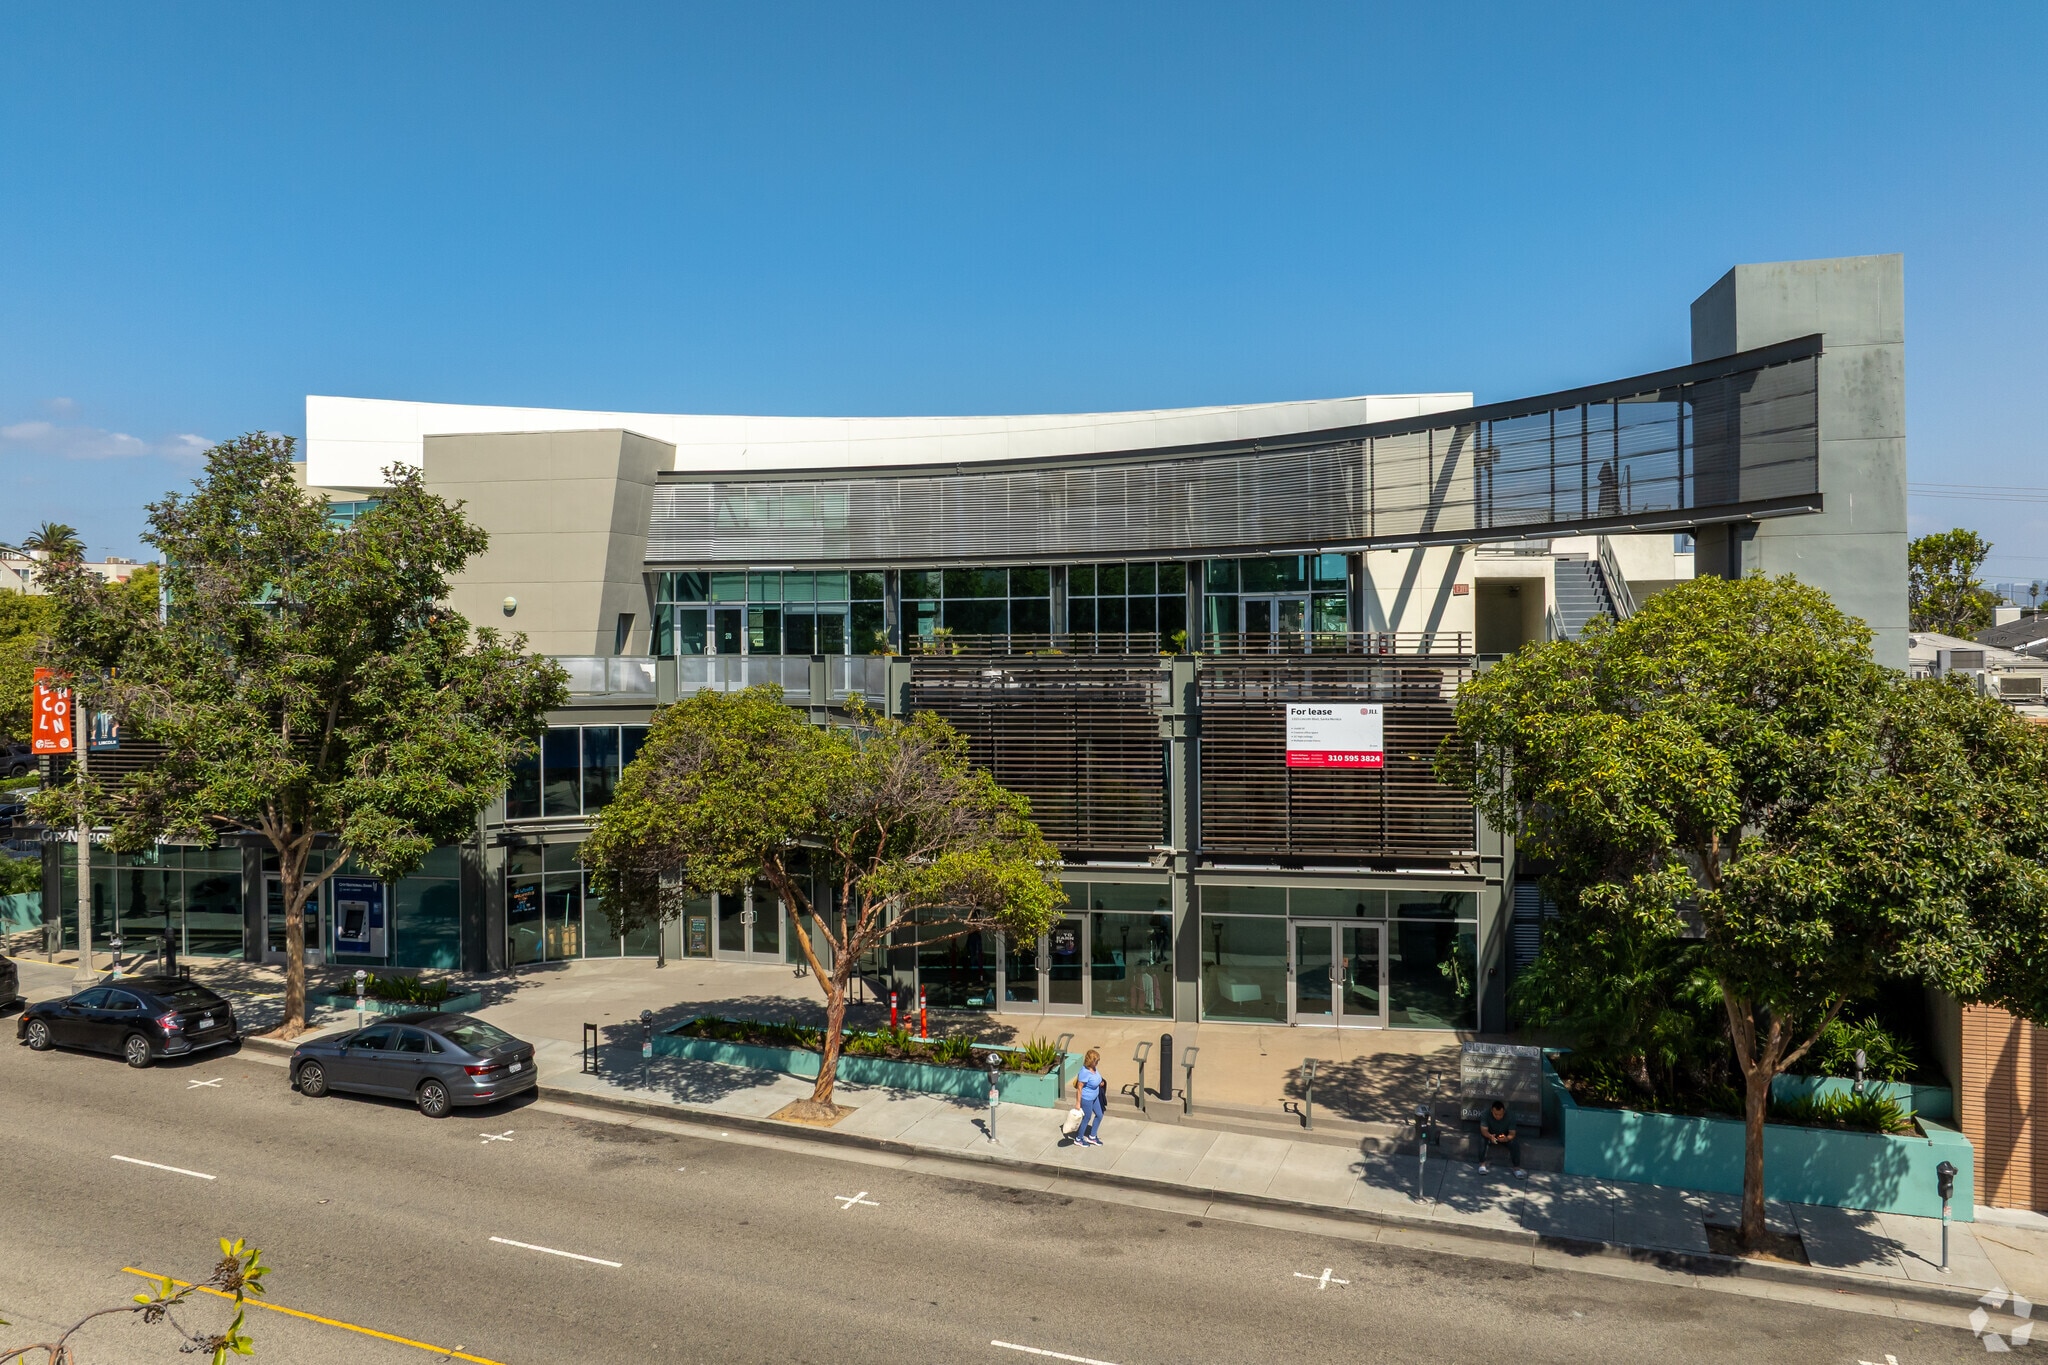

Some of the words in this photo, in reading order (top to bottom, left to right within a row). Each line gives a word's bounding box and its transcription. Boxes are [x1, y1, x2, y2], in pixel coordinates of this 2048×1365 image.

[1361, 755, 1380, 763] 3824
[41, 829, 66, 842] CITY
[1462, 1109, 1482, 1117] PARK
